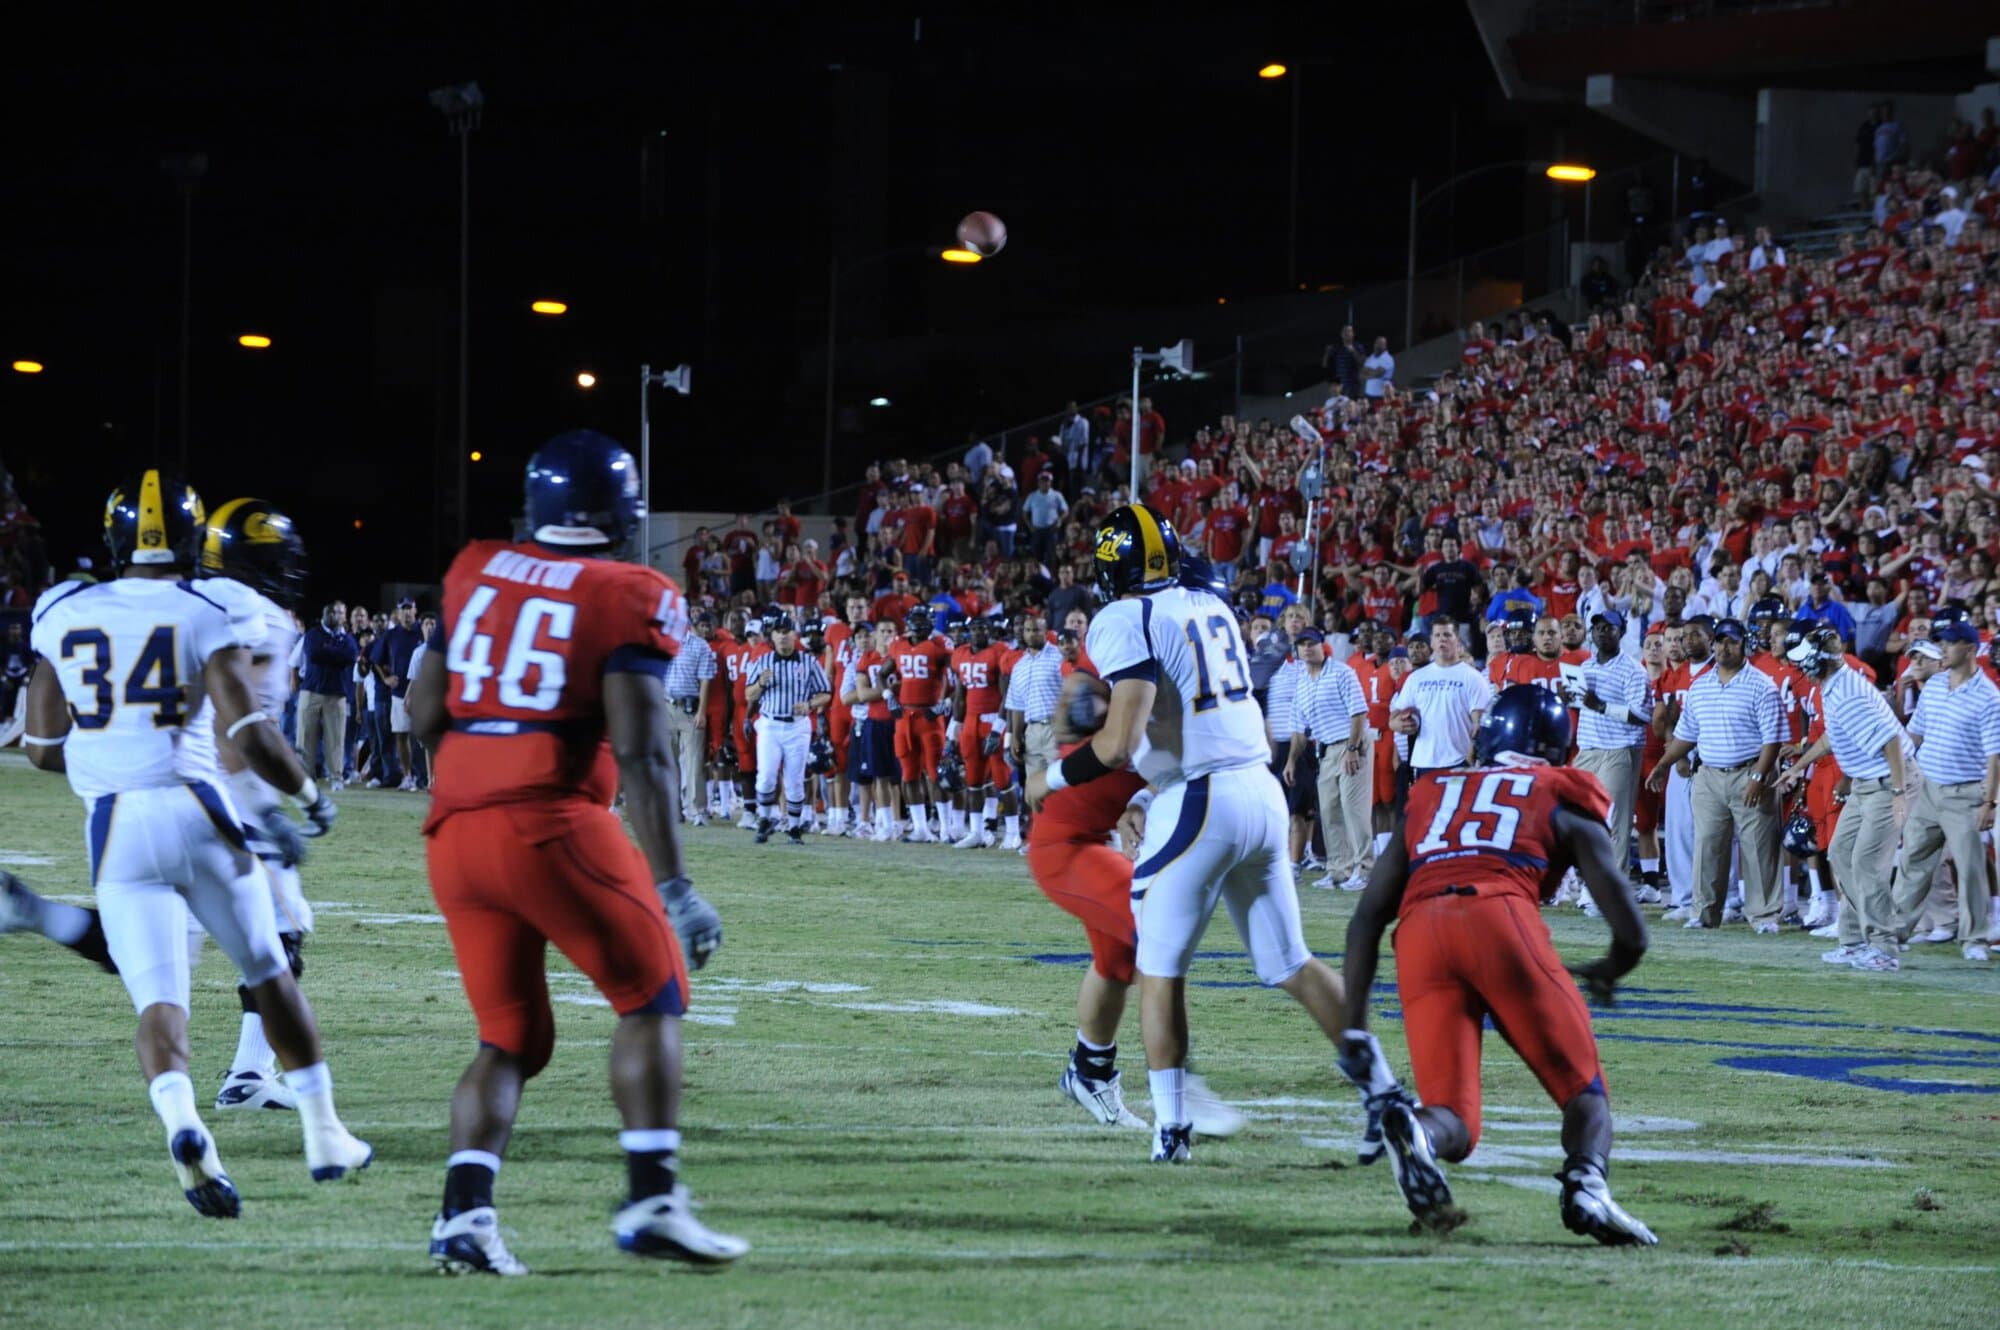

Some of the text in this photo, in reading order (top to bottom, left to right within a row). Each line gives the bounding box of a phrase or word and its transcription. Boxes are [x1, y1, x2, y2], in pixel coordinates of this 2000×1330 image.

[1096, 526, 1127, 561] Cal
[60, 624, 187, 732] 34
[446, 584, 577, 712] 46
[900, 653, 928, 679] 26
[960, 662, 987, 689] 35
[1185, 614, 1250, 715] 13
[1416, 772, 1534, 854] 15
